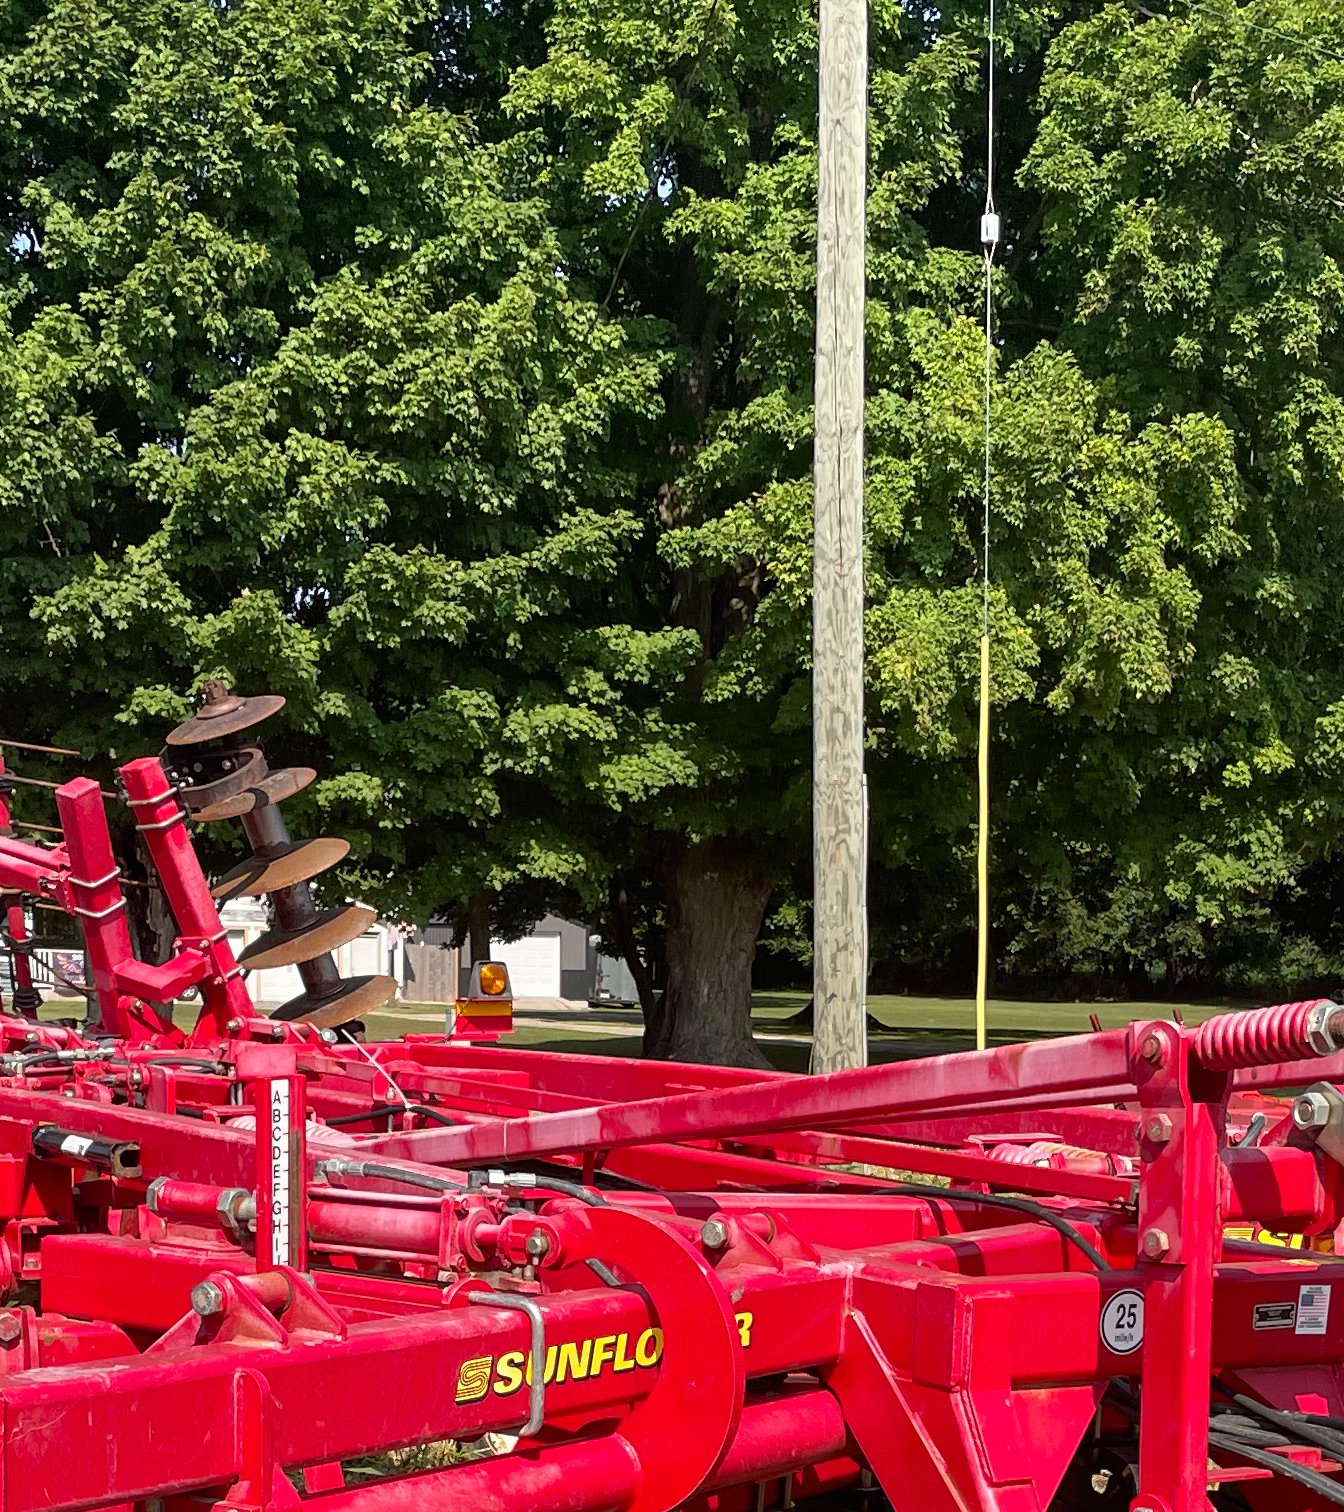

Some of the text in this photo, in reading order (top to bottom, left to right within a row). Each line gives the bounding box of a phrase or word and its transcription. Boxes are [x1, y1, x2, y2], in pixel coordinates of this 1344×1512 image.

[272, 1089, 282, 1105] A
[273, 1108, 281, 1123] B
[272, 1126, 282, 1142] C
[272, 1146, 281, 1160] D
[273, 1164, 281, 1179] E
[274, 1182, 281, 1197] F
[272, 1200, 282, 1216] G
[272, 1219, 282, 1234] H
[1115, 1303, 1138, 1329] 25
